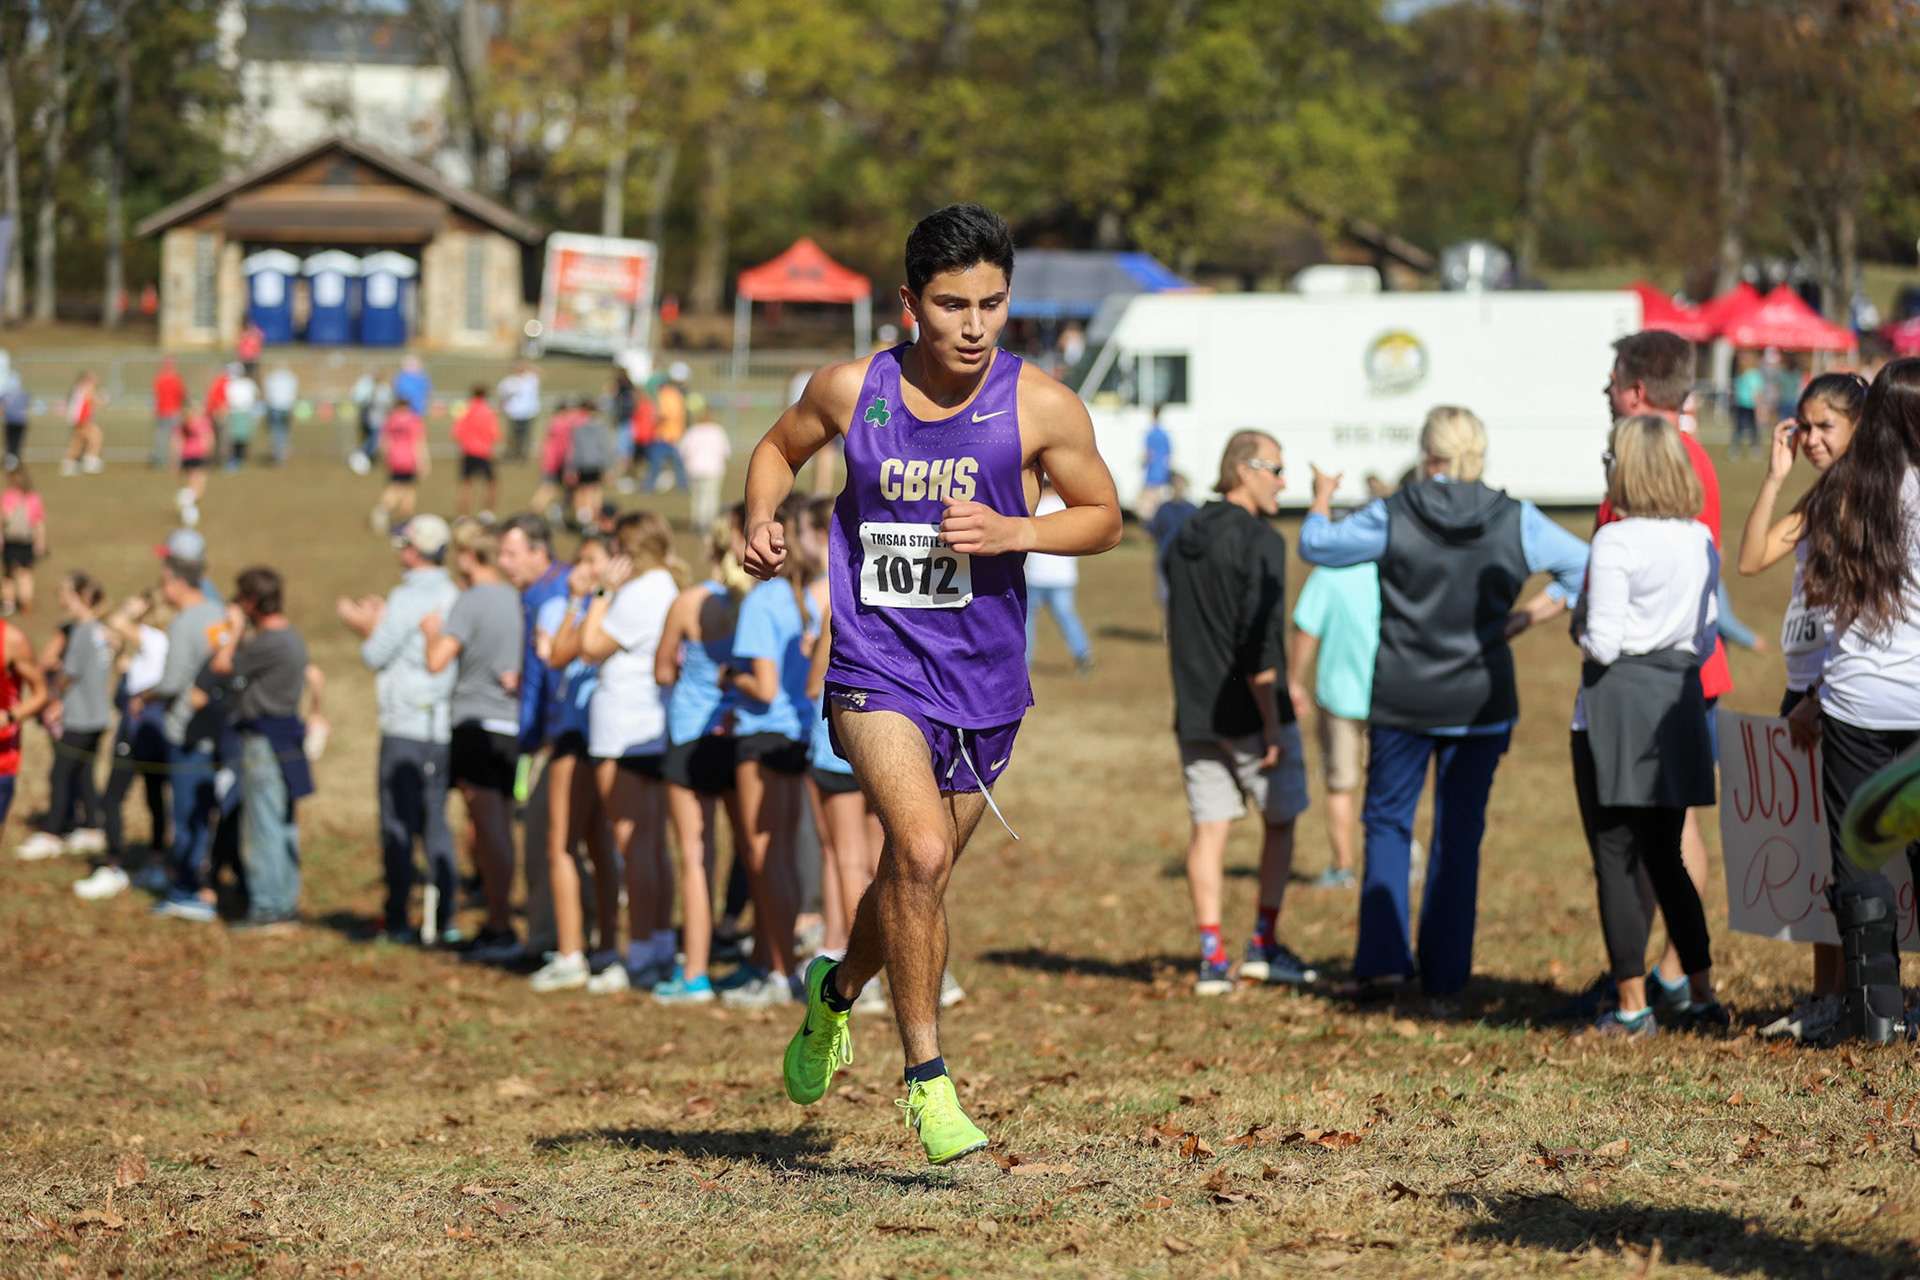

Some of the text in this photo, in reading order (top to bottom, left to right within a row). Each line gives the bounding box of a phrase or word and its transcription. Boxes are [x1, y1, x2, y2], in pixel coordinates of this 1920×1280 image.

[880, 457, 979, 501] CBHS
[871, 533, 907, 547] TMSAA
[873, 555, 959, 595] 1072
[1784, 613, 1817, 643] 1175
